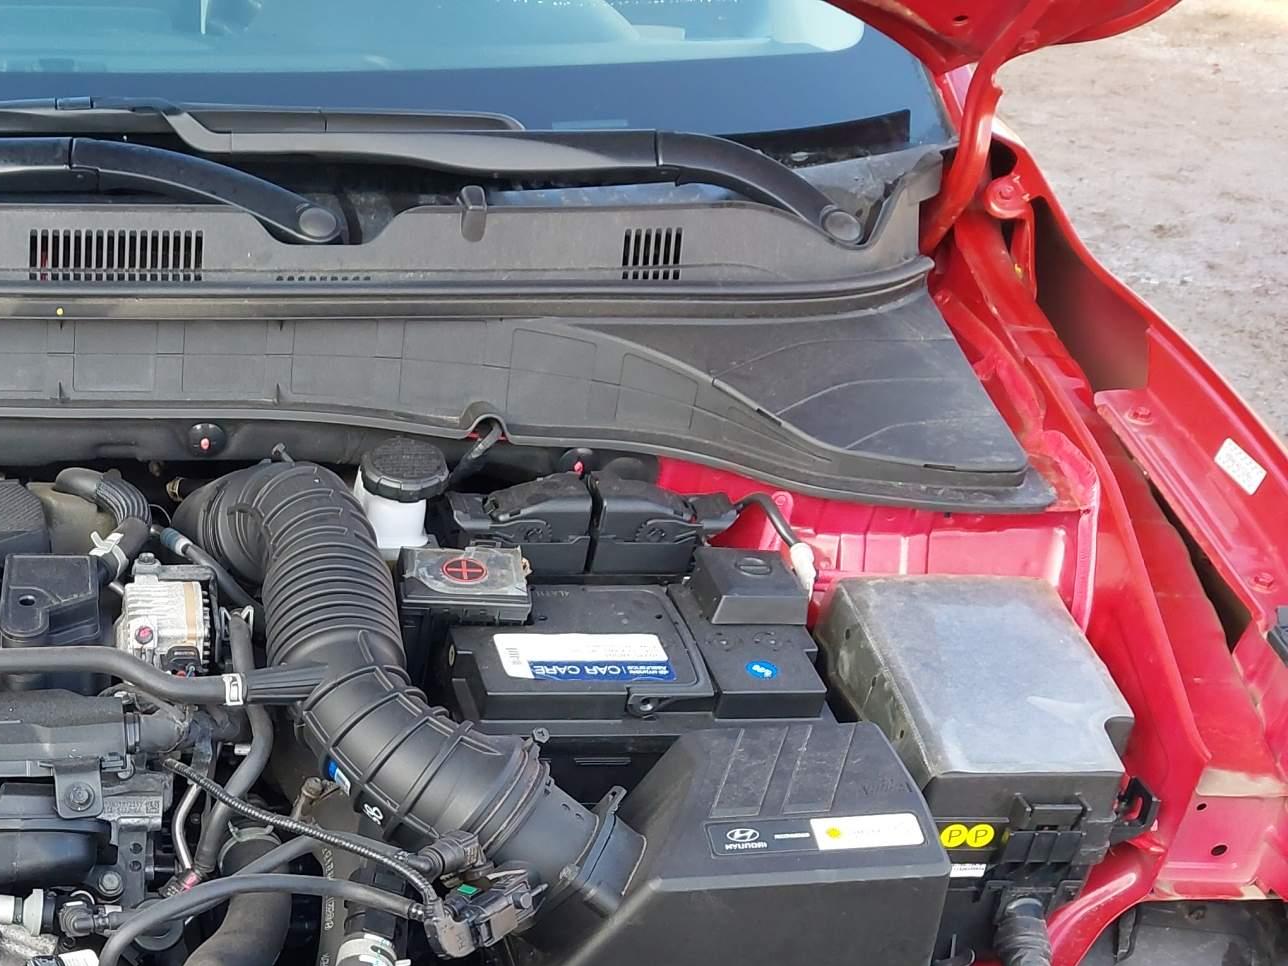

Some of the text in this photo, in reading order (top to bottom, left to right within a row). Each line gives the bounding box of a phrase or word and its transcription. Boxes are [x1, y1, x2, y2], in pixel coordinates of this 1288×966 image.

[532, 665, 621, 675] CAR CARE
[724, 841, 768, 851] HYUNDAI
